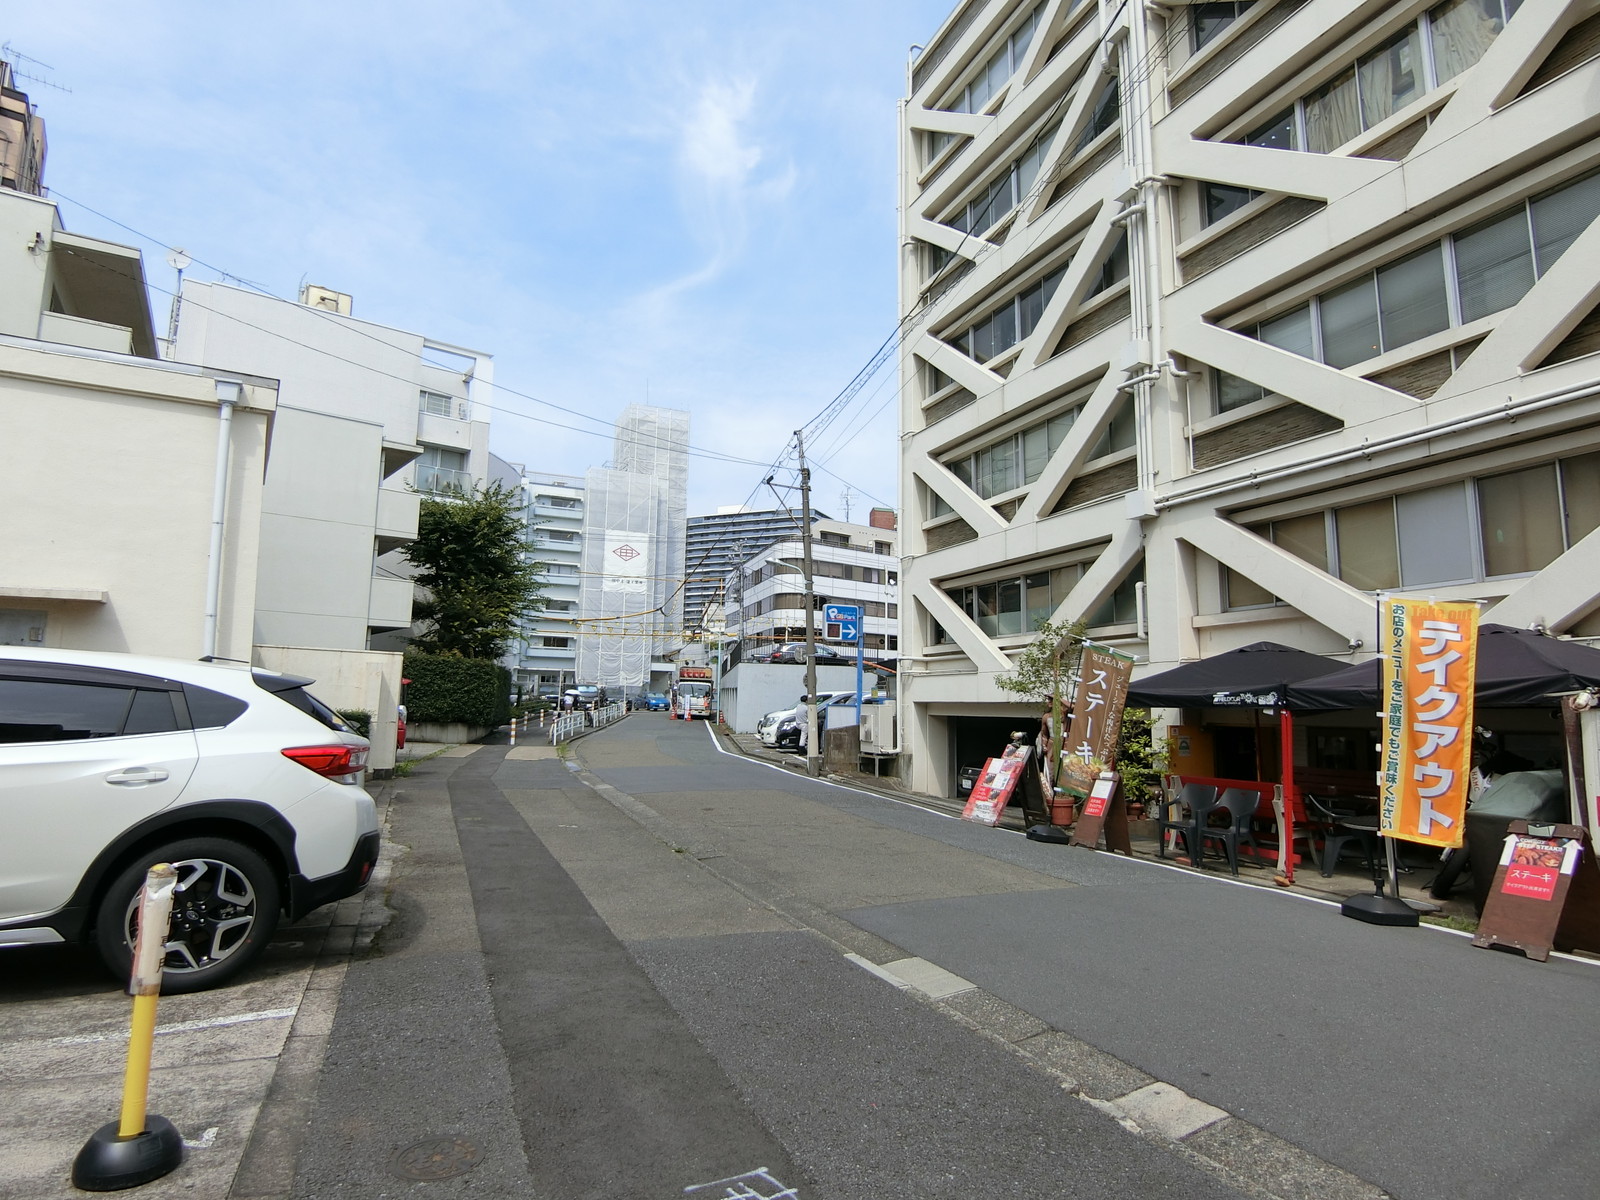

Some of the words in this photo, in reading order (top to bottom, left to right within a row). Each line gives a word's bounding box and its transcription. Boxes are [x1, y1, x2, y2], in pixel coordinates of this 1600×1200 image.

[1411, 605, 1444, 618] Take
[1092, 653, 1125, 670] STEAK
[1075, 667, 1107, 765] ステーキ
[1380, 604, 1405, 830] お店のメニューをご家庭でもご賞味ください
[1413, 620, 1463, 837] テイクアウト
[1510, 869, 1552, 883] ステーキ
